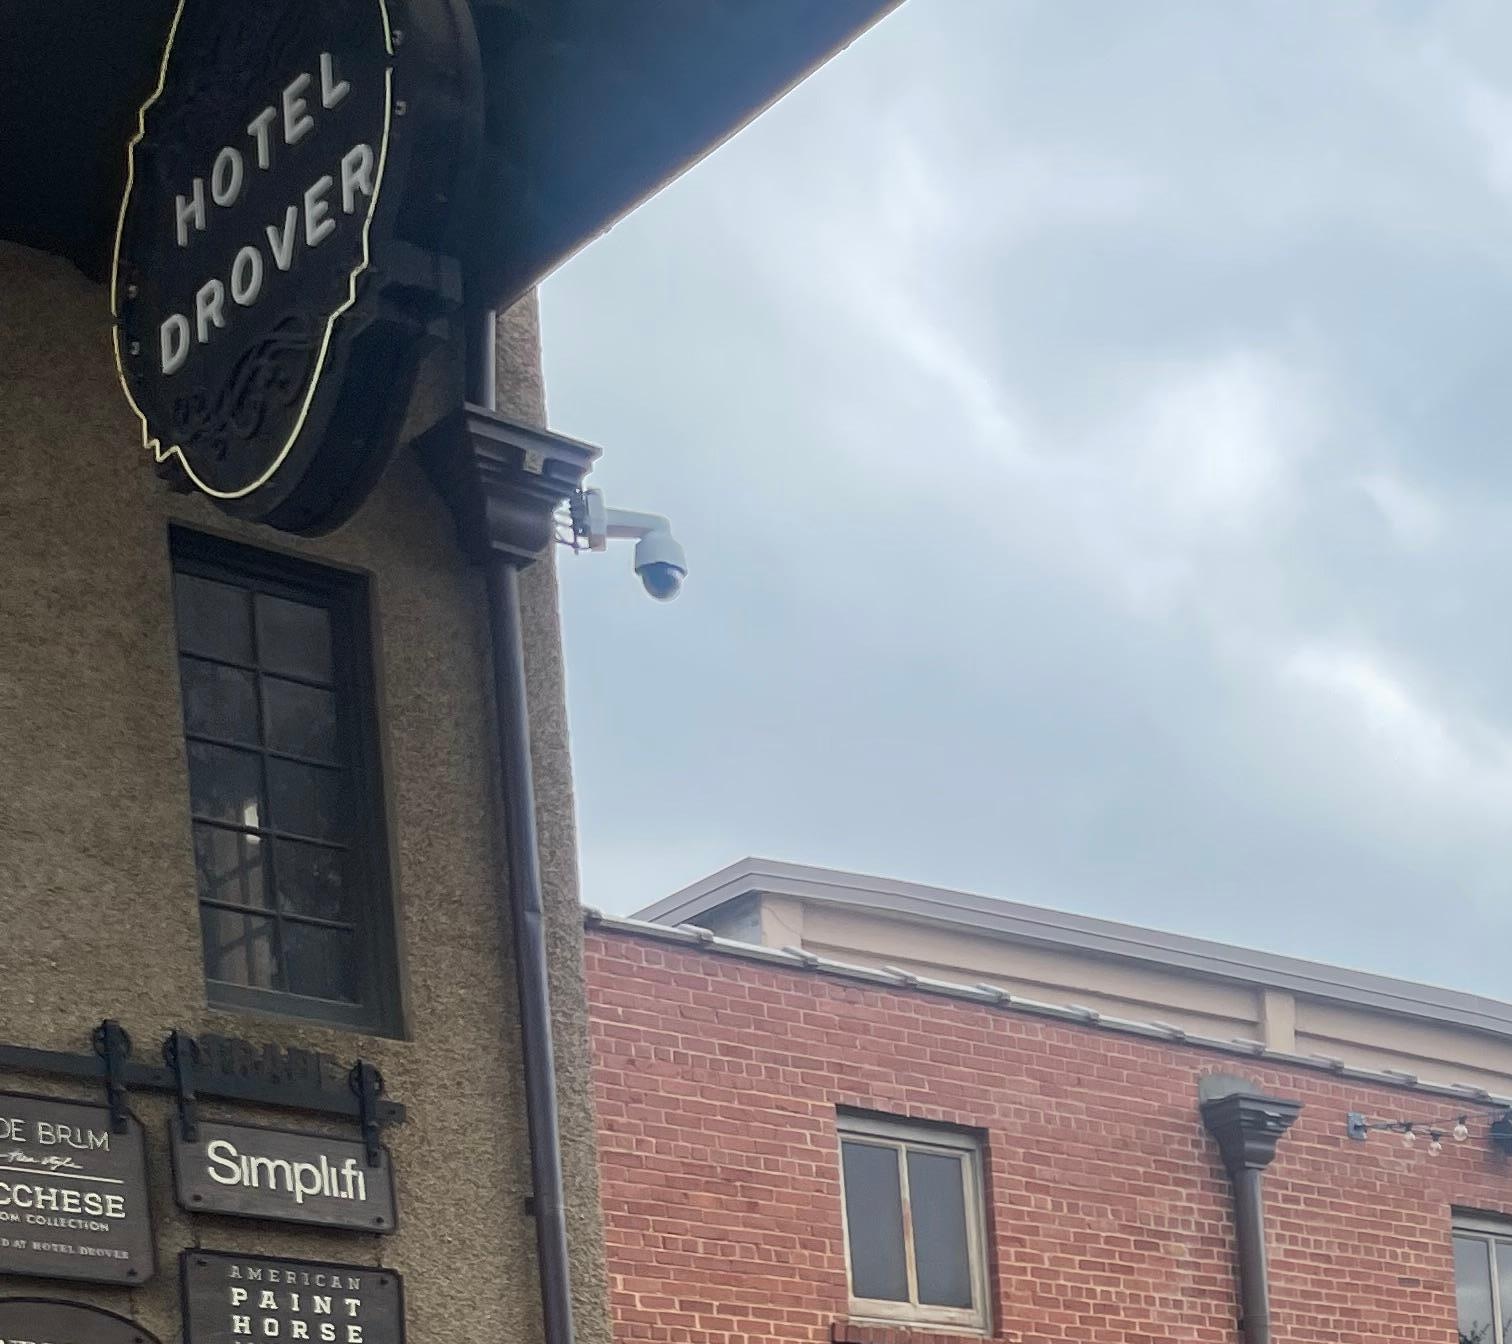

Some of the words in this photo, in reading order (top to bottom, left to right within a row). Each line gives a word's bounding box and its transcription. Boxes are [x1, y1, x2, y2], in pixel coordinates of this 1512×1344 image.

[175, 52, 350, 248] HOTEL
[160, 143, 376, 376] DROVER
[38, 1121, 110, 1151] BRIM
[26, 1213, 109, 1232] COLLECTION
[228, 1265, 361, 1290] AMERICAN
[230, 1286, 361, 1317] PAINT
[232, 1314, 363, 1344] HORSE
